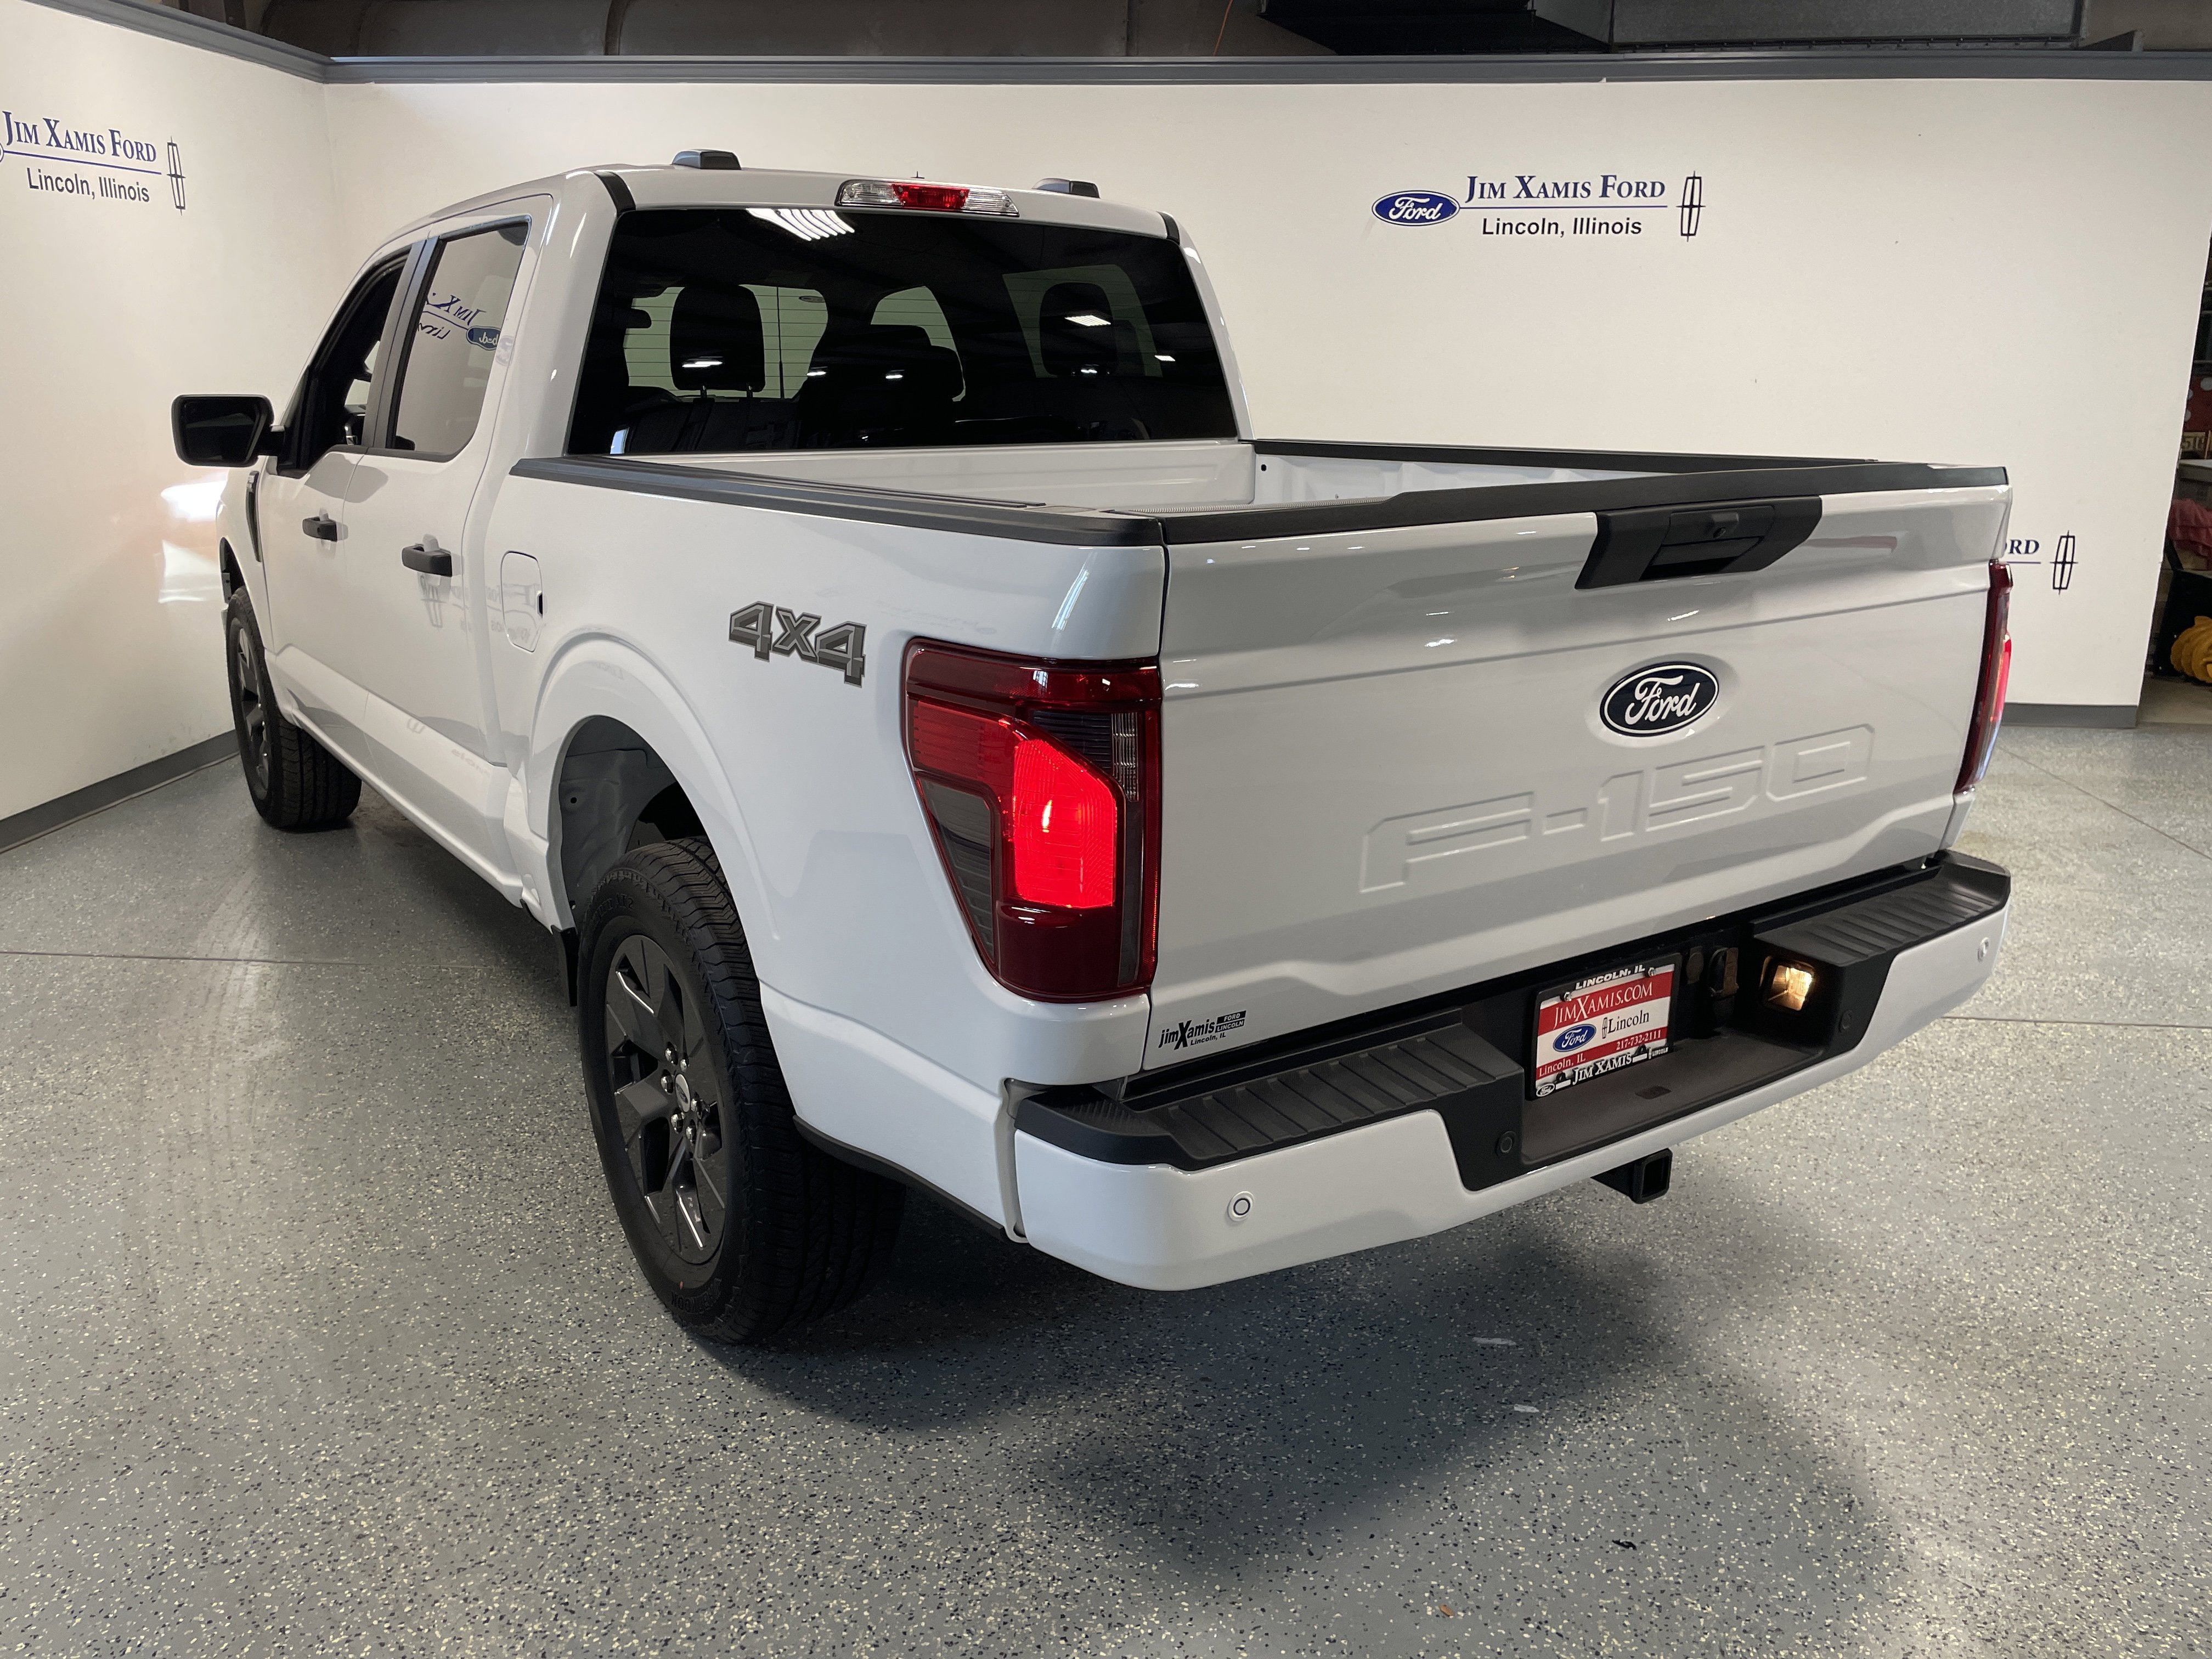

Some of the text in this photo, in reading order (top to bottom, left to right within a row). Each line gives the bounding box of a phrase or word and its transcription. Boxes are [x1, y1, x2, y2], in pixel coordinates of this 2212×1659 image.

[2, 111, 156, 162] JIM XAMIS FORD
[27, 167, 150, 202] Lincoln, Illinois
[1465, 174, 1666, 203] JIM XAMIS FORD
[1388, 197, 1442, 220] Ford
[1482, 217, 1642, 238] Lincoln, Illinois
[1625, 674, 1700, 725] Ford
[1359, 724, 1875, 894] F-150
[1575, 964, 1645, 990] LINCOLN, IL
[1217, 1020, 1244, 1032] LINCOLN
[1224, 1013, 1240, 1022] FORD
[1608, 1010, 1650, 1033] Lincoln
[1190, 1035, 1217, 1046] Lincoln,
[1561, 1028, 1587, 1048] Ford
[1616, 1030, 1661, 1051] 217-732-2111
[1539, 1053, 1585, 1077] Lincoln, IL
[1572, 1053, 1632, 1085] JIM XAMIS
